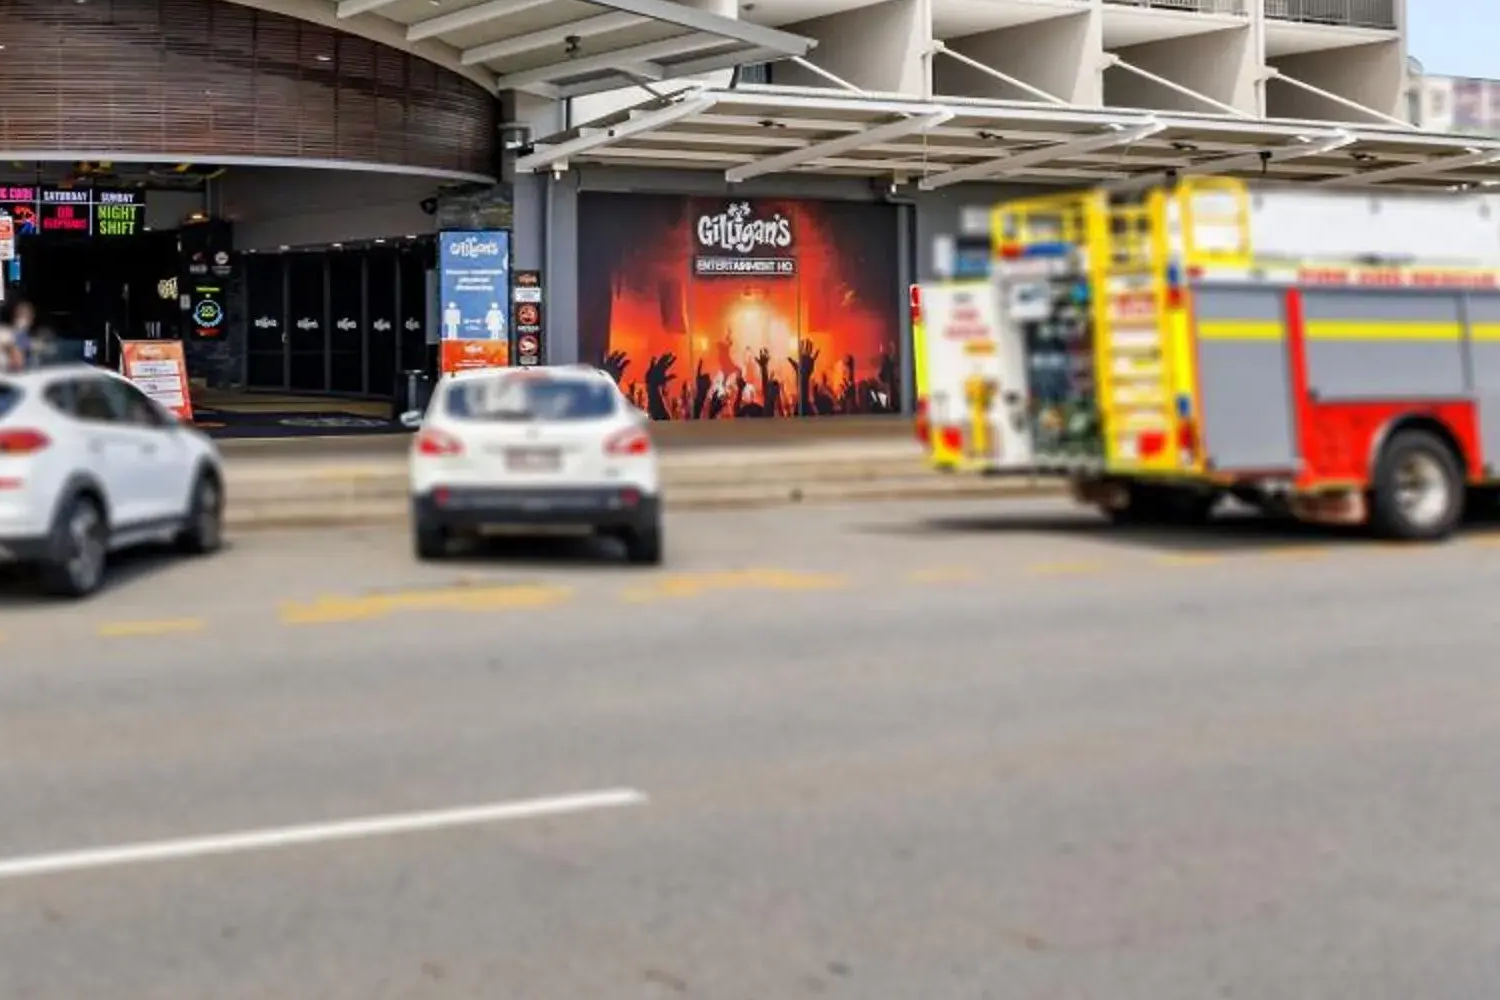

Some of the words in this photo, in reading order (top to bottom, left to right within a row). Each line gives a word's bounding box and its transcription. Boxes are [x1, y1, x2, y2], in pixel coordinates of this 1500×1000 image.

[43, 190, 88, 201] SATURDAY
[97, 204, 137, 220] NIGHT
[99, 220, 135, 235] SHIFT
